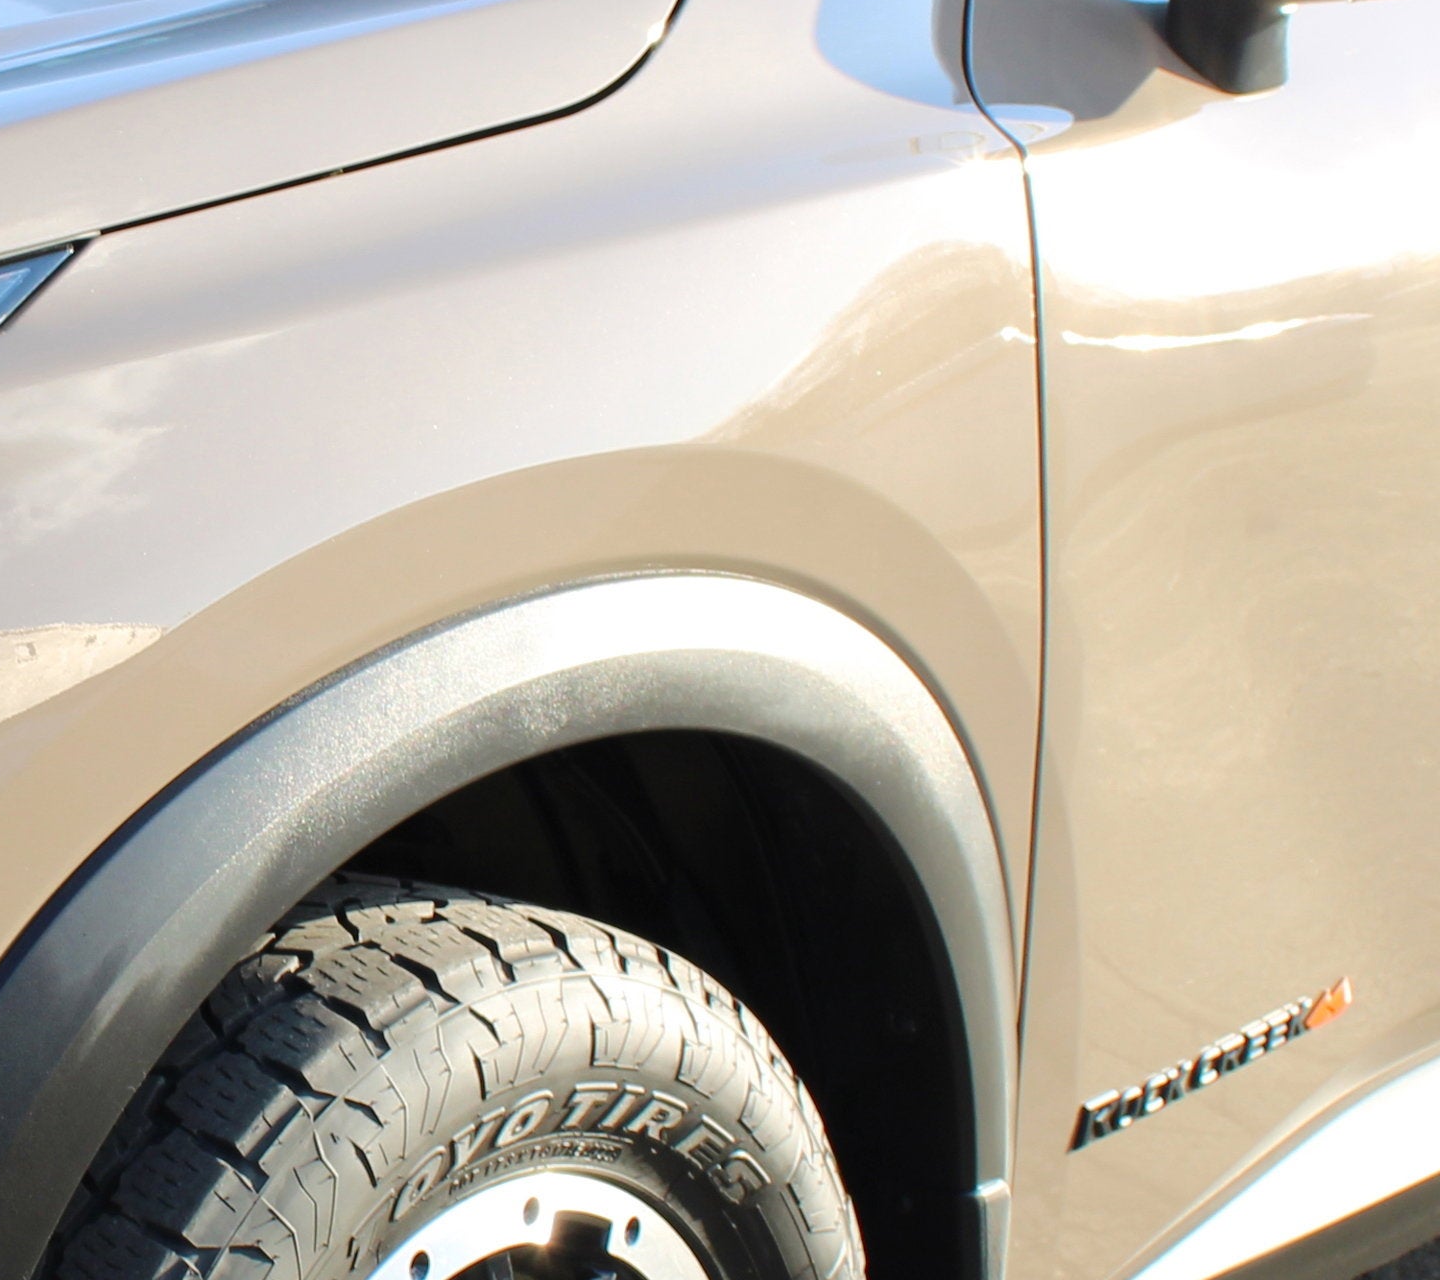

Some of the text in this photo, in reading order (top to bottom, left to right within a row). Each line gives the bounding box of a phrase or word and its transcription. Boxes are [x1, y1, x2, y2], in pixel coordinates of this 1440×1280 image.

[560, 1081, 773, 1207] TIRES
[1066, 995, 1316, 1154] ROCK CREEK
